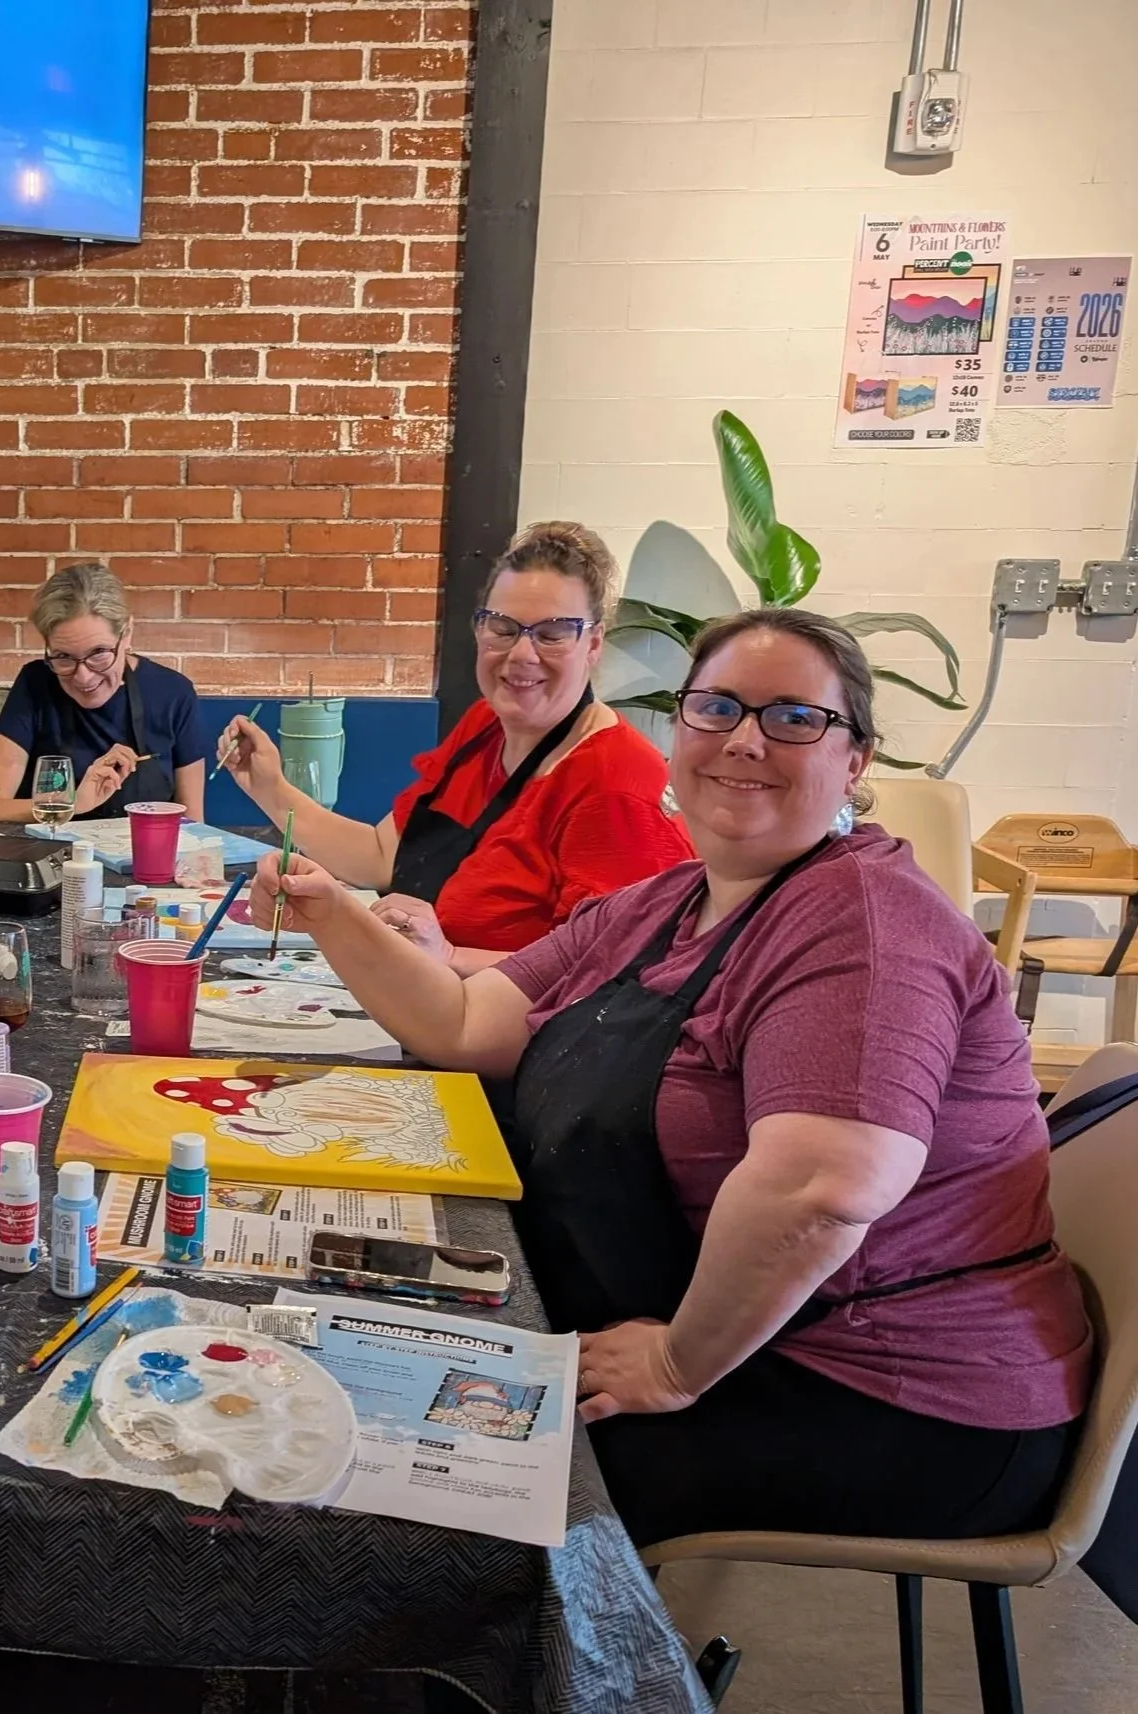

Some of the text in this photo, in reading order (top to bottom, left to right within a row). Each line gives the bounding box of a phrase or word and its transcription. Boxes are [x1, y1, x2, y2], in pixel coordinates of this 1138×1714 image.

[906, 101, 915, 136] FIRE
[909, 221, 1006, 233] MOUNTAINS & FLOWERS
[876, 233, 890, 252] 6
[910, 234, 1001, 253] Paint Party!
[915, 259, 949, 268] PERCENT
[1076, 293, 1124, 338] 2026
[1073, 344, 1118, 352] SCHEDULE
[954, 358, 981, 371] $35
[950, 385, 978, 397] $40
[850, 430, 912, 438] CHOOSE YOUR COLORS
[127, 1179, 157, 1245] MUSHROOM GNOME
[337, 1318, 425, 1341] SUMMER
[429, 1331, 505, 1353] GNOME
[415, 1462, 439, 1471] STEP
